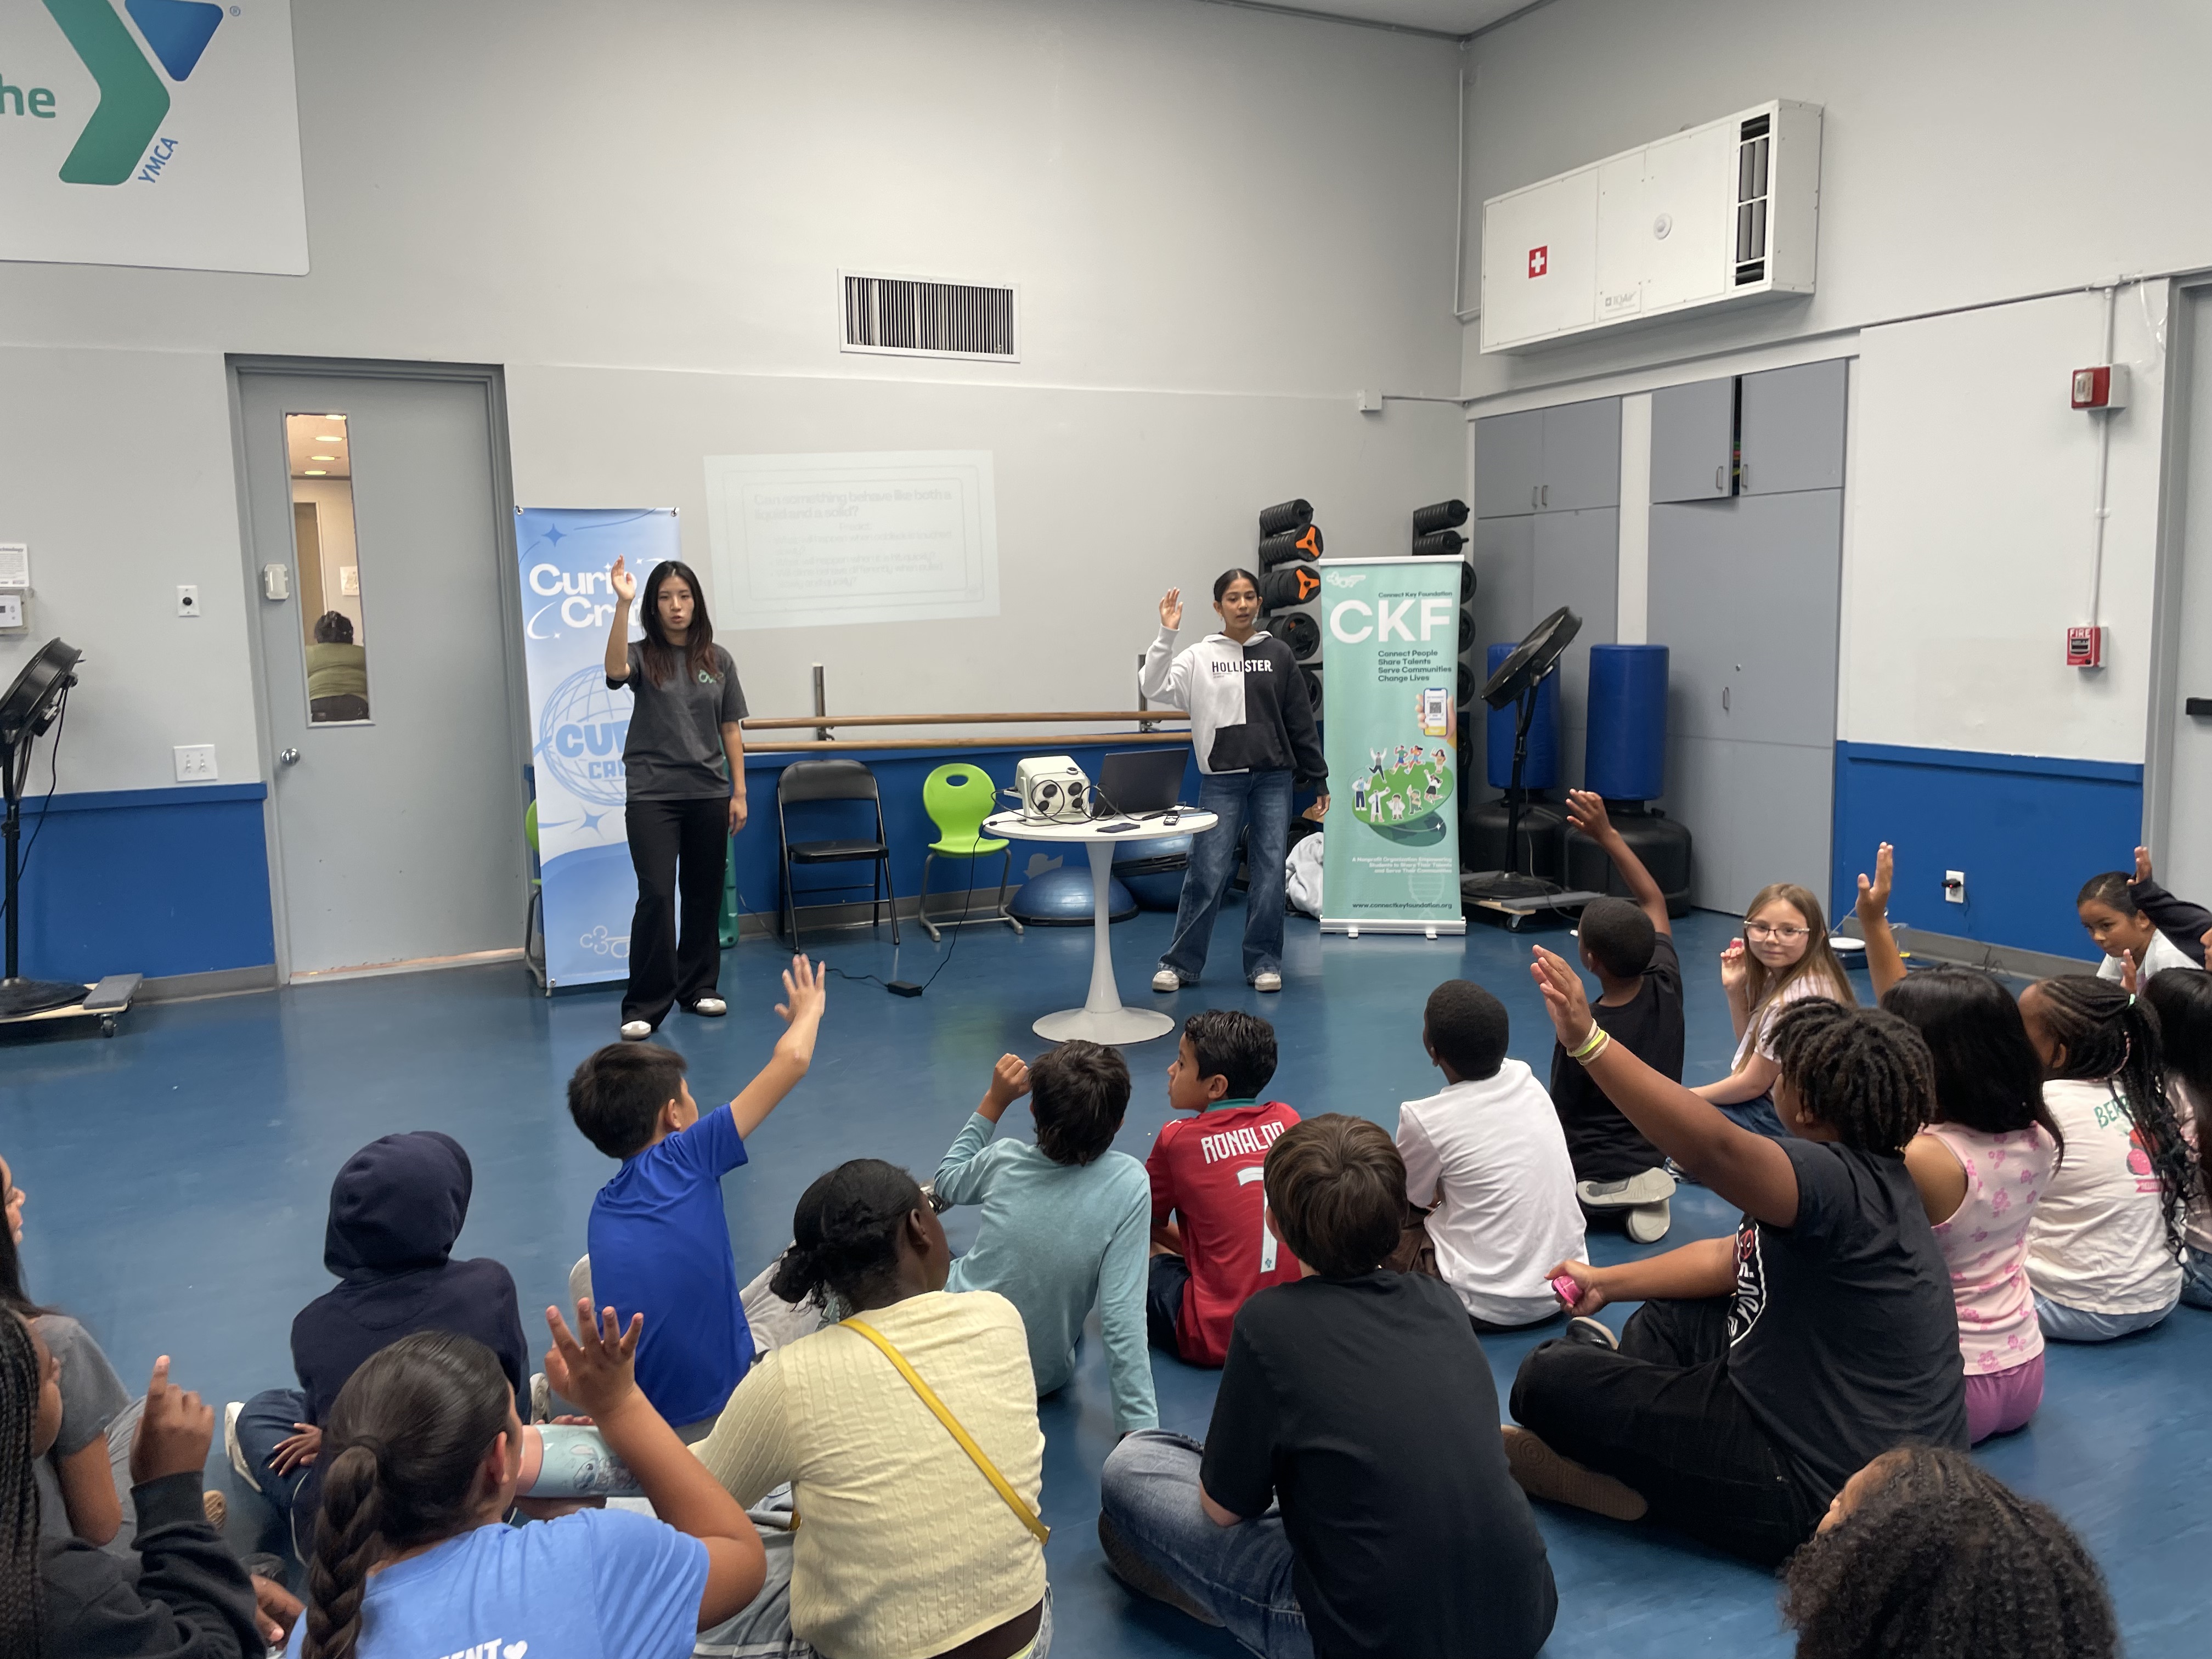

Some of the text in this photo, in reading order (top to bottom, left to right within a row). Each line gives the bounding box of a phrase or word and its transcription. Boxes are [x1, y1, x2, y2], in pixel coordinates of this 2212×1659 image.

[138, 137, 178, 183] YMCA
[1330, 599, 1453, 644] CKF
[1212, 659, 1272, 673] HOLLISTER
[1412, 650, 1438, 658] People
